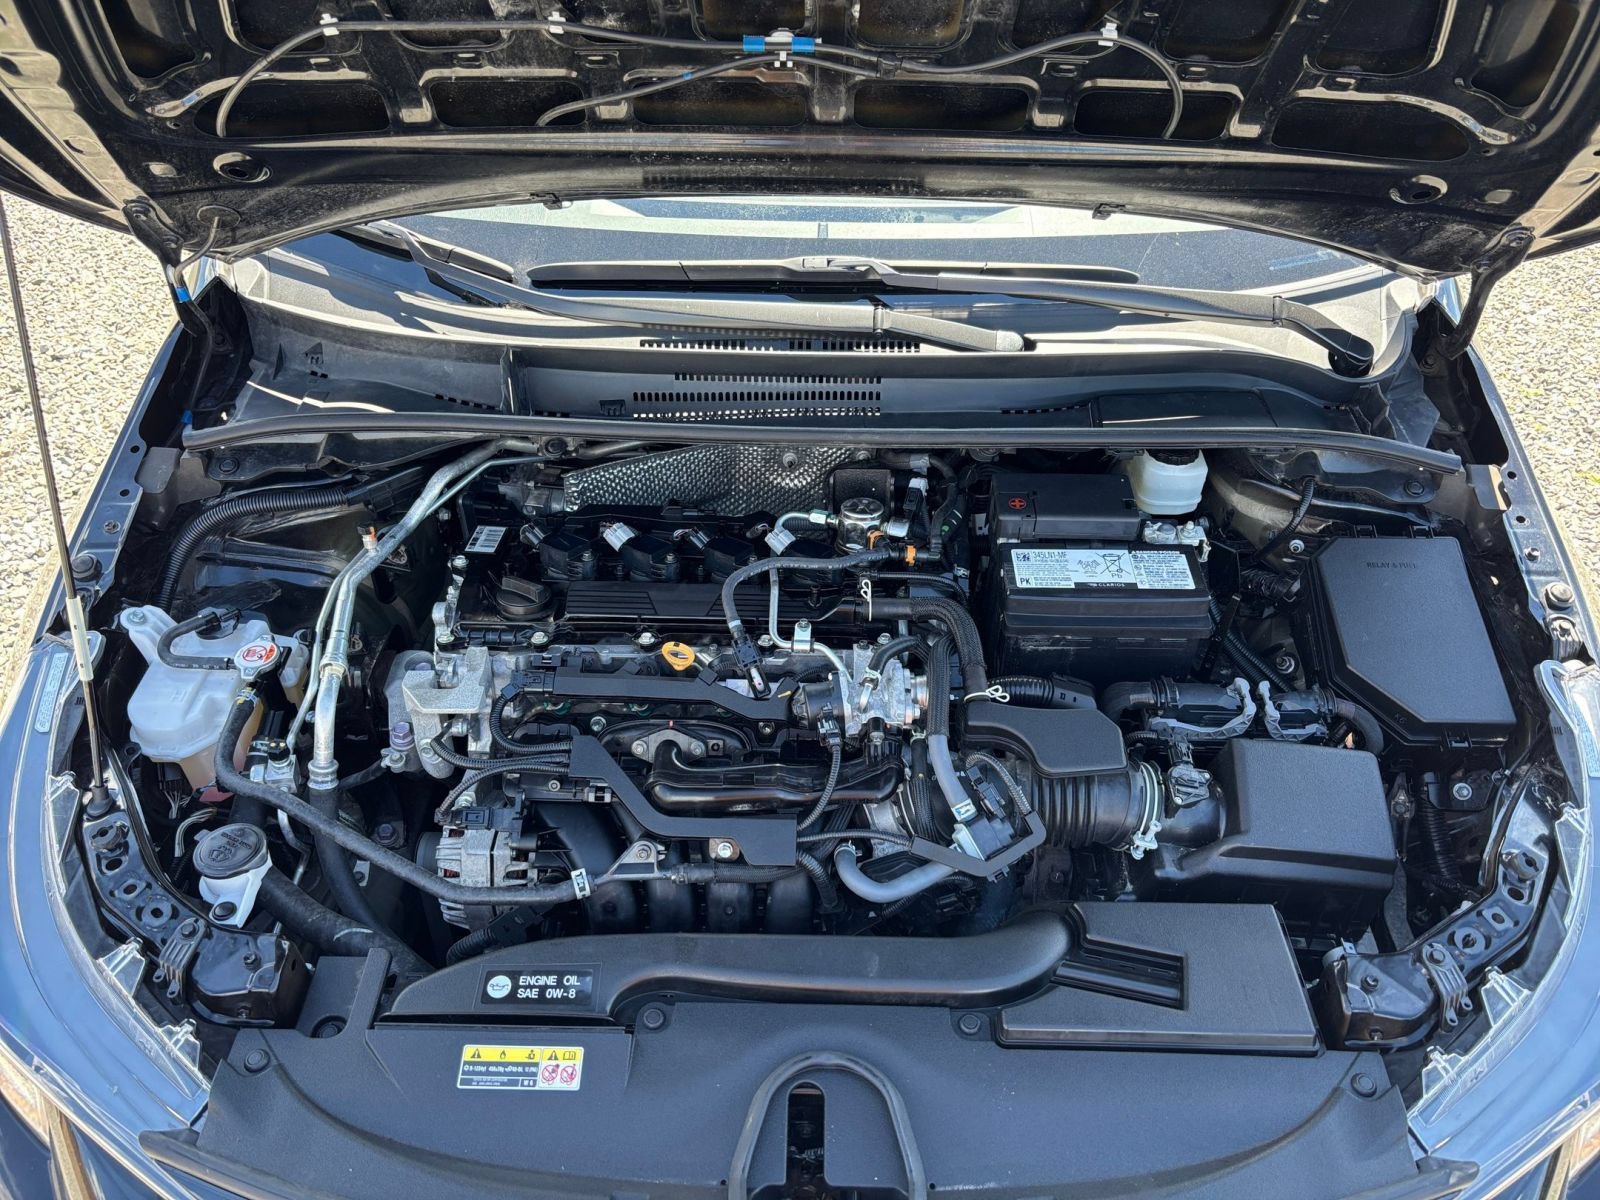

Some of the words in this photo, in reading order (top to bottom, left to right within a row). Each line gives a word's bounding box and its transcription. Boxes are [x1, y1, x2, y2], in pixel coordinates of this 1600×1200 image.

[1020, 578, 1031, 586] PK
[519, 975, 558, 986] ENGINE
[563, 975, 581, 986] OIL
[516, 988, 540, 999] SAE
[545, 988, 576, 999] 0W-8
